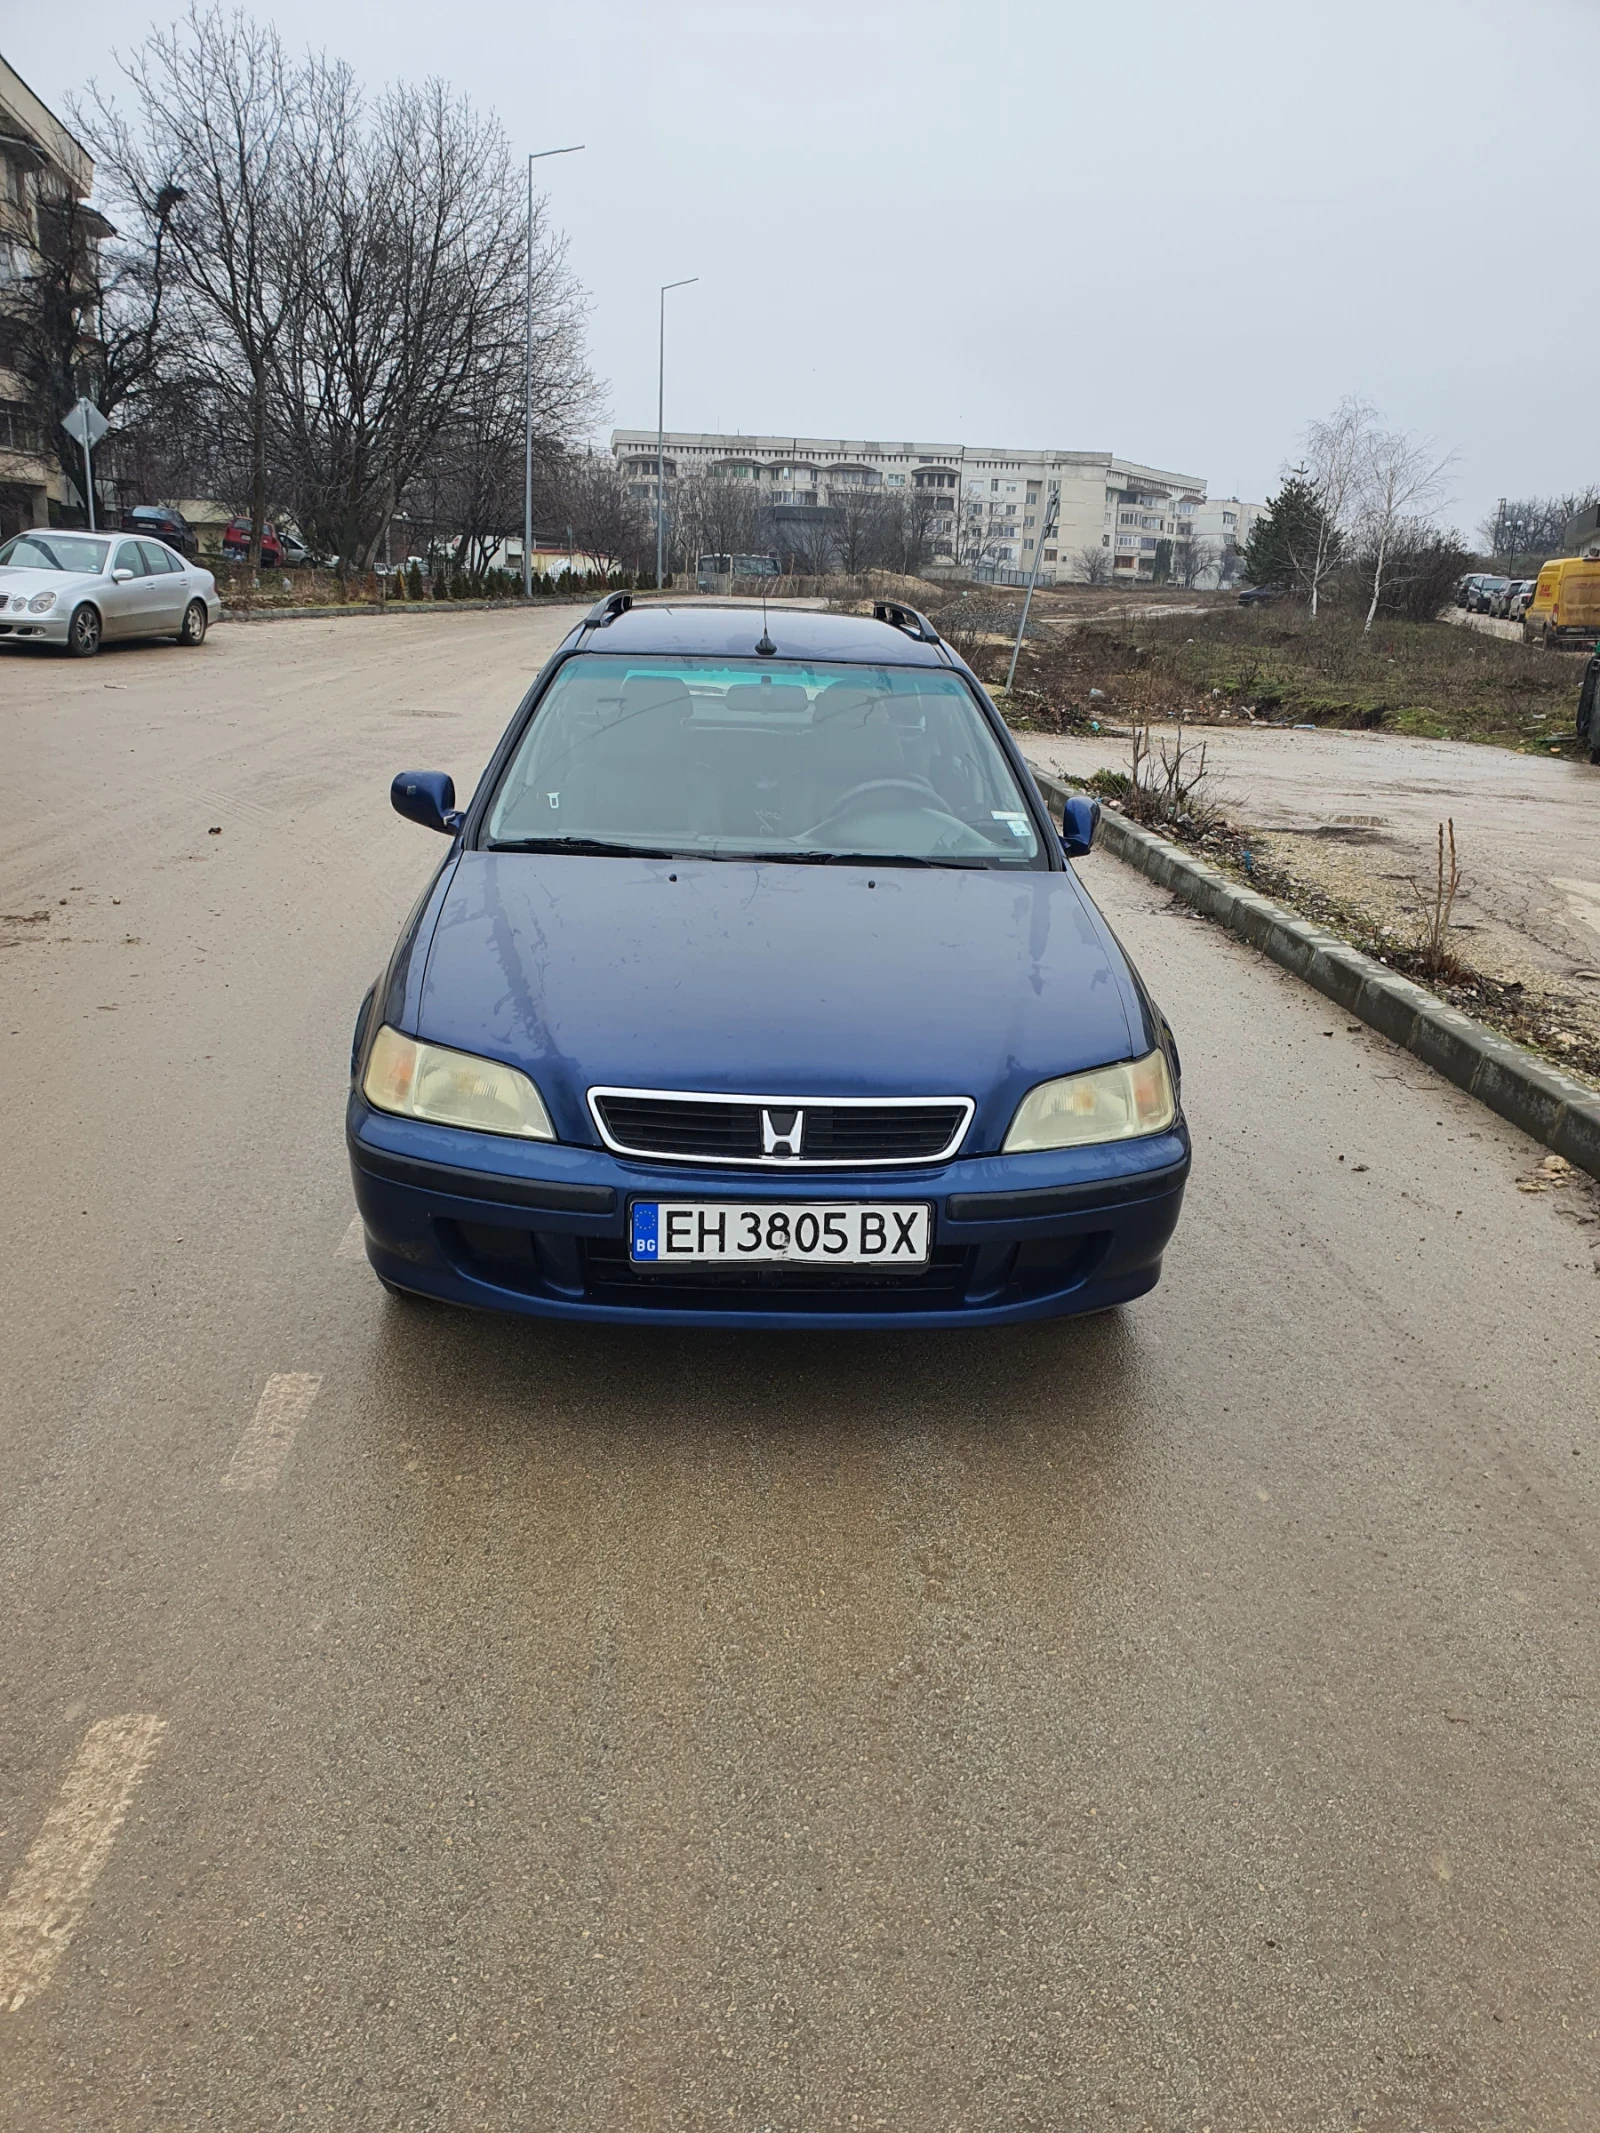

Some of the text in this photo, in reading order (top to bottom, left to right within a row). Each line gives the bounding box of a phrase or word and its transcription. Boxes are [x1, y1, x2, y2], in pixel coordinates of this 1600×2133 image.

[637, 1239, 656, 1252] BG
[666, 1210, 919, 1255] EH 3805 BX
